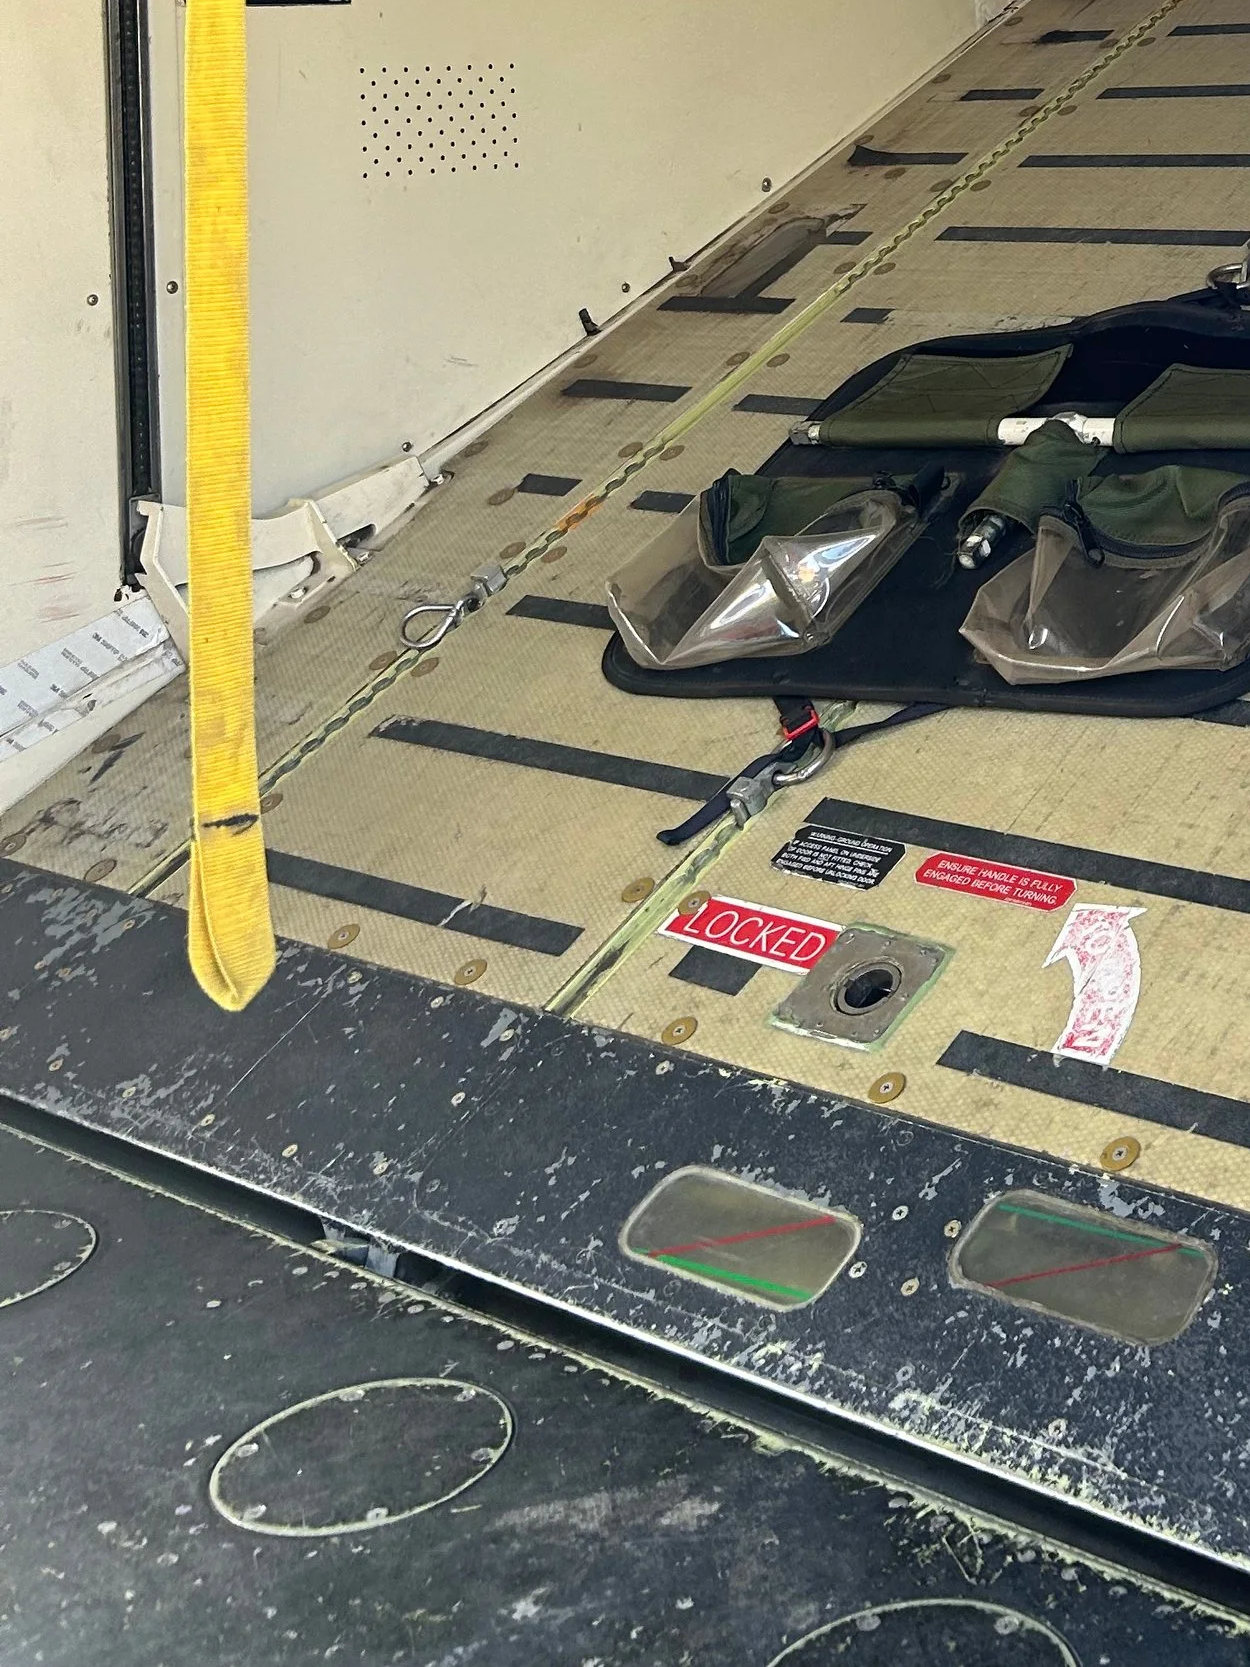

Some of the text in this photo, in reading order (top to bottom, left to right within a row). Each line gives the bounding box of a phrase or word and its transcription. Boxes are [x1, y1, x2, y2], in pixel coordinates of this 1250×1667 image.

[796, 847, 812, 856] DOOR
[852, 859, 873, 868] CHECK
[799, 841, 822, 850] ACCESS
[822, 845, 839, 855] PANEL
[775, 858, 803, 869] ENGAGED
[803, 864, 826, 874] BEFORE
[825, 868, 858, 881] UNLOCKING
[781, 852, 799, 860] BOTH
[836, 863, 853, 872] HINGE
[923, 868, 971, 886] ENGAGED
[971, 879, 1012, 895] BEFORE
[1013, 887, 1058, 905] TURNING.
[937, 859, 1062, 893] ENSURE HANDLE IS FULLY
[683, 902, 826, 962] LOCKED
